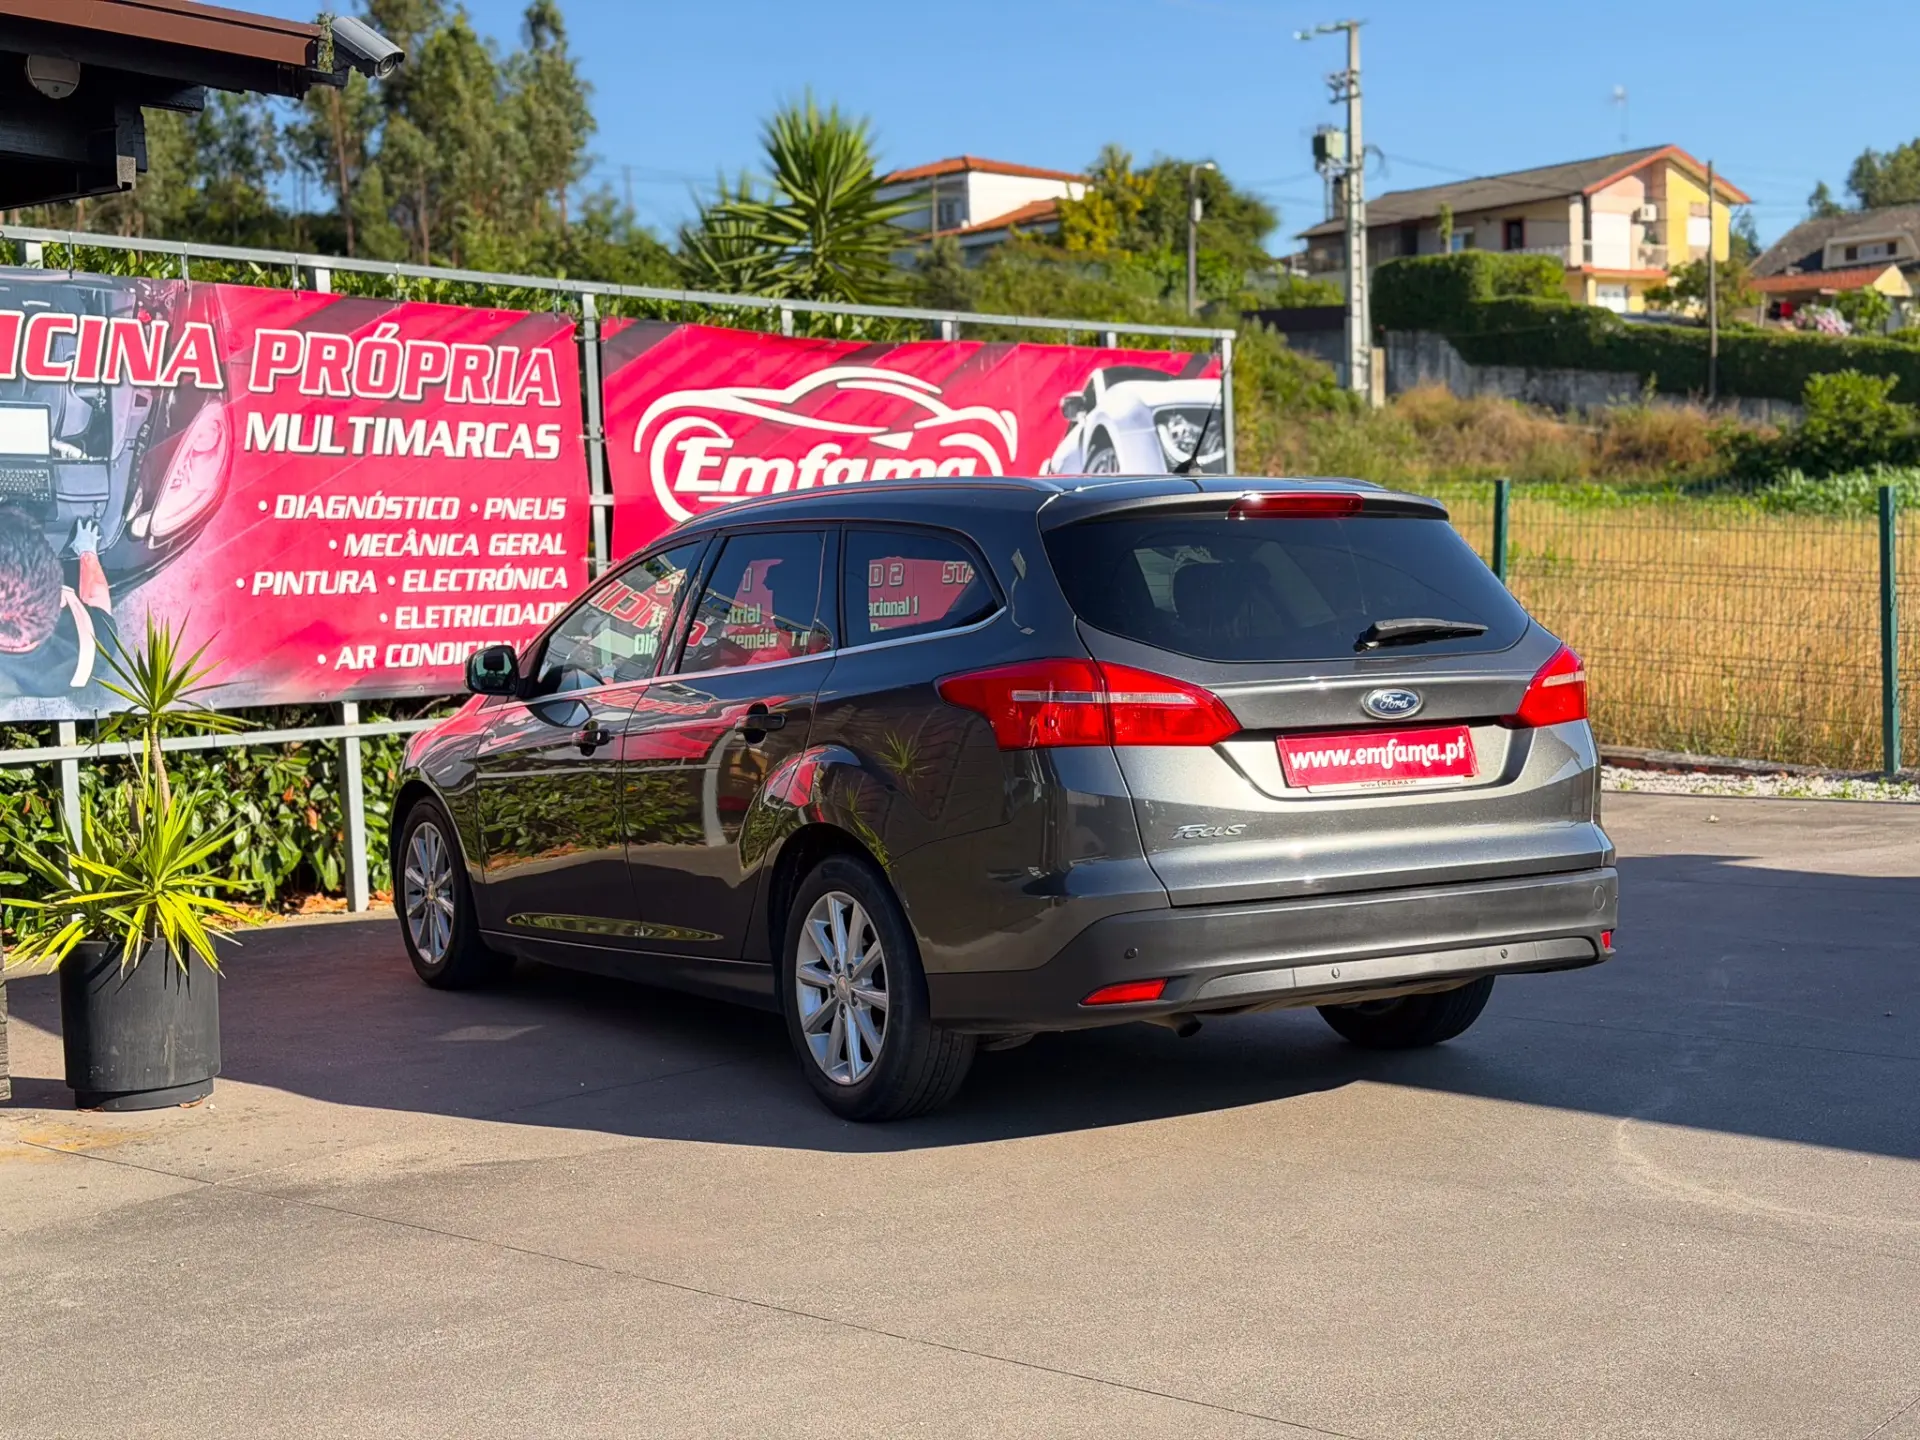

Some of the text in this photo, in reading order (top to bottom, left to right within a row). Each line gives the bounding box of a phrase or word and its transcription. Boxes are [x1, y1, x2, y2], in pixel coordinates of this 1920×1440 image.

[248, 322, 561, 406] PRÓPRIA
[244, 411, 562, 460] MULTIMARCAS
[675, 436, 977, 493] Emfama
[274, 491, 567, 520] DIAGNÓSTICO PNEUS
[343, 528, 567, 558] MECÂNICA GERAL
[252, 563, 568, 596] PINTURA ELECTRÓNICA
[335, 645, 377, 670] AR
[1380, 693, 1409, 709] Ford
[1290, 736, 1467, 770] www.emfama.pt
